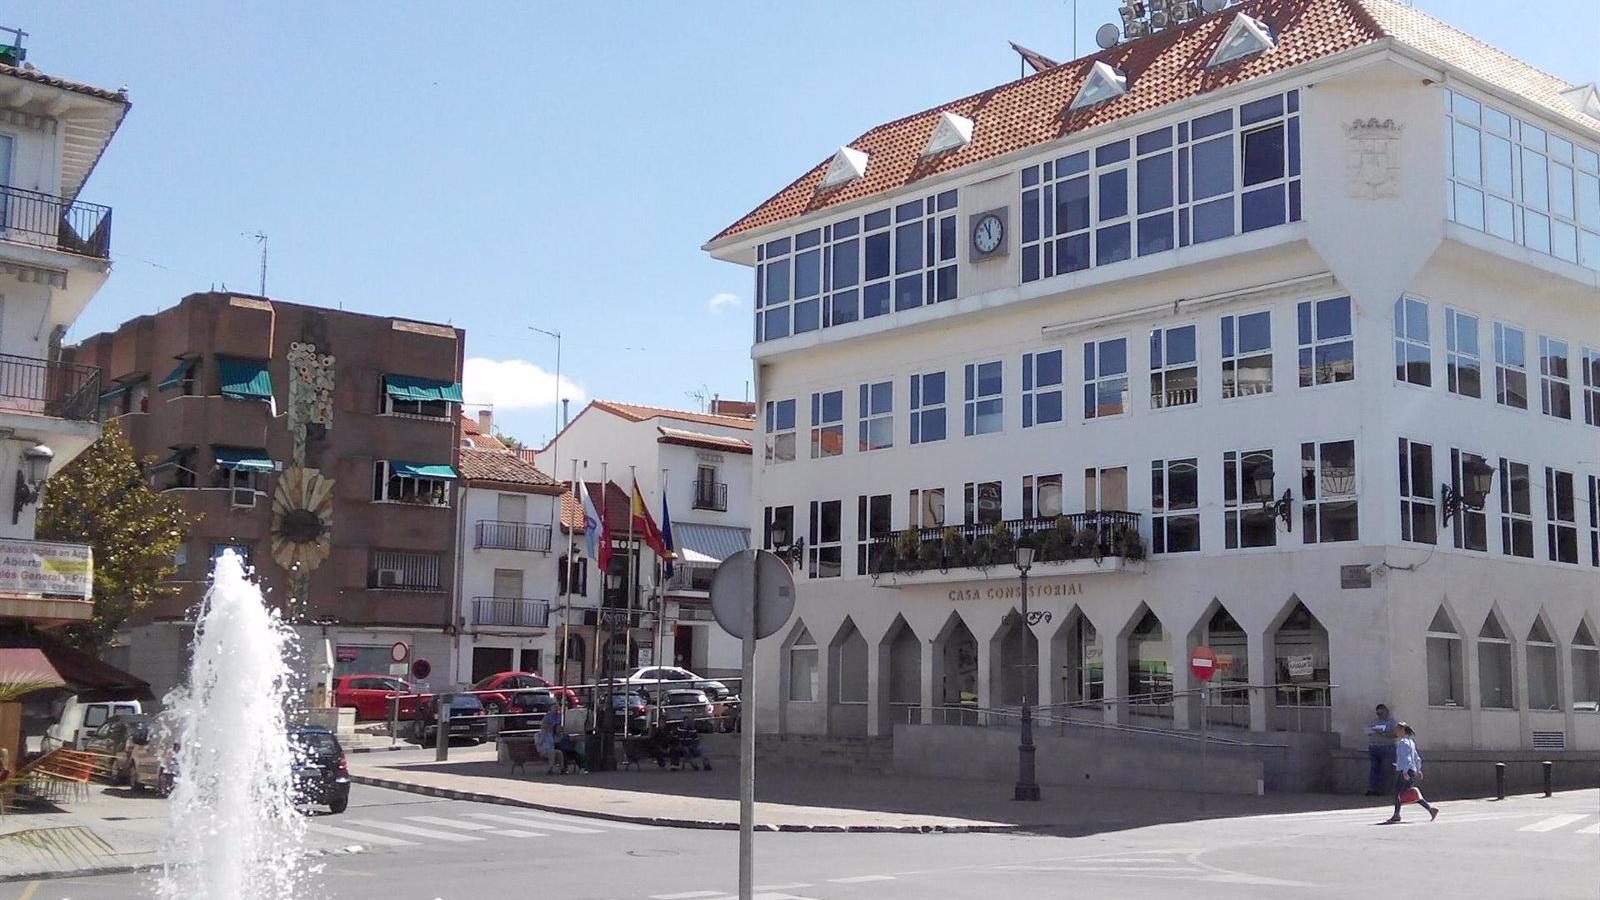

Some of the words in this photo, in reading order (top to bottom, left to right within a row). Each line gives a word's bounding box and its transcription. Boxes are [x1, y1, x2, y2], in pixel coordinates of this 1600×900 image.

[20, 570, 61, 582] General
[948, 589, 981, 601] CASA
[987, 583, 1084, 600] CONSSTORIAL
